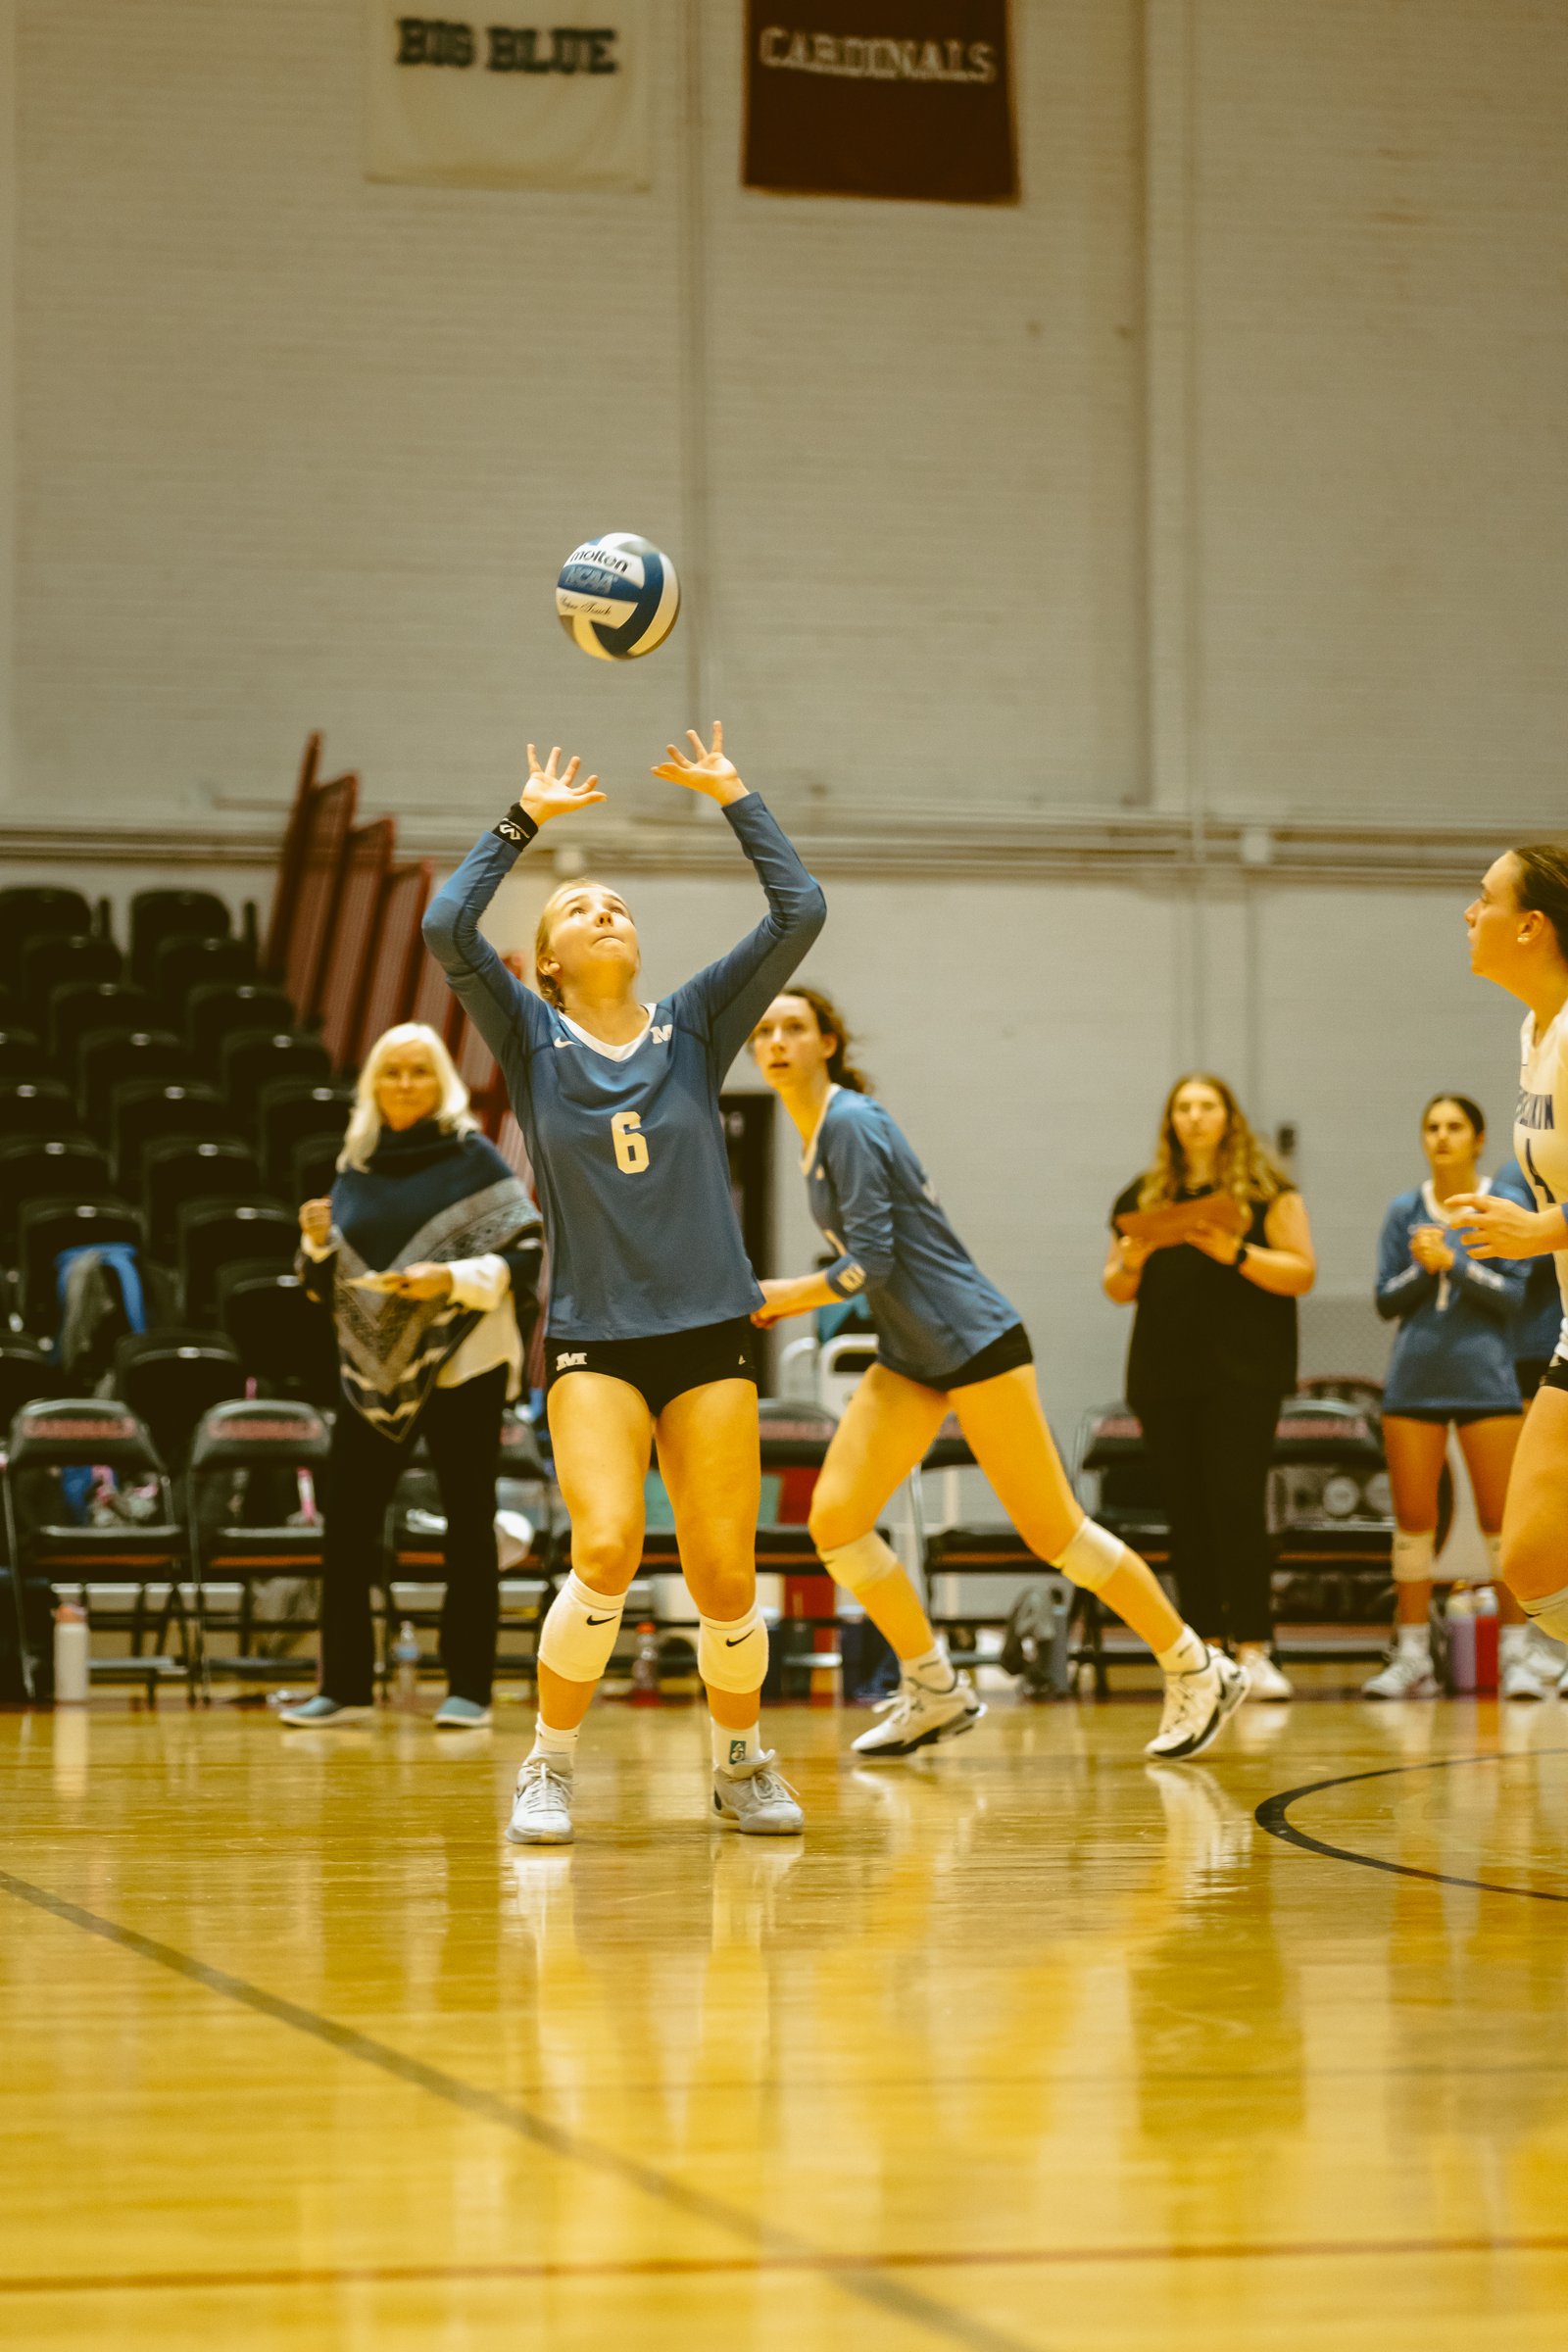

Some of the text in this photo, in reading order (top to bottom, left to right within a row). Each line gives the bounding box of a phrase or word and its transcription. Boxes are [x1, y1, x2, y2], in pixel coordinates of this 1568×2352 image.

[396, 17, 618, 74] BIG BLUE
[760, 26, 998, 83] CARDINALS
[569, 550, 628, 573] molten
[564, 565, 614, 595] NCAA
[579, 601, 612, 615] Touch
[611, 1110, 650, 1174] 6
[556, 1352, 587, 1371] M
